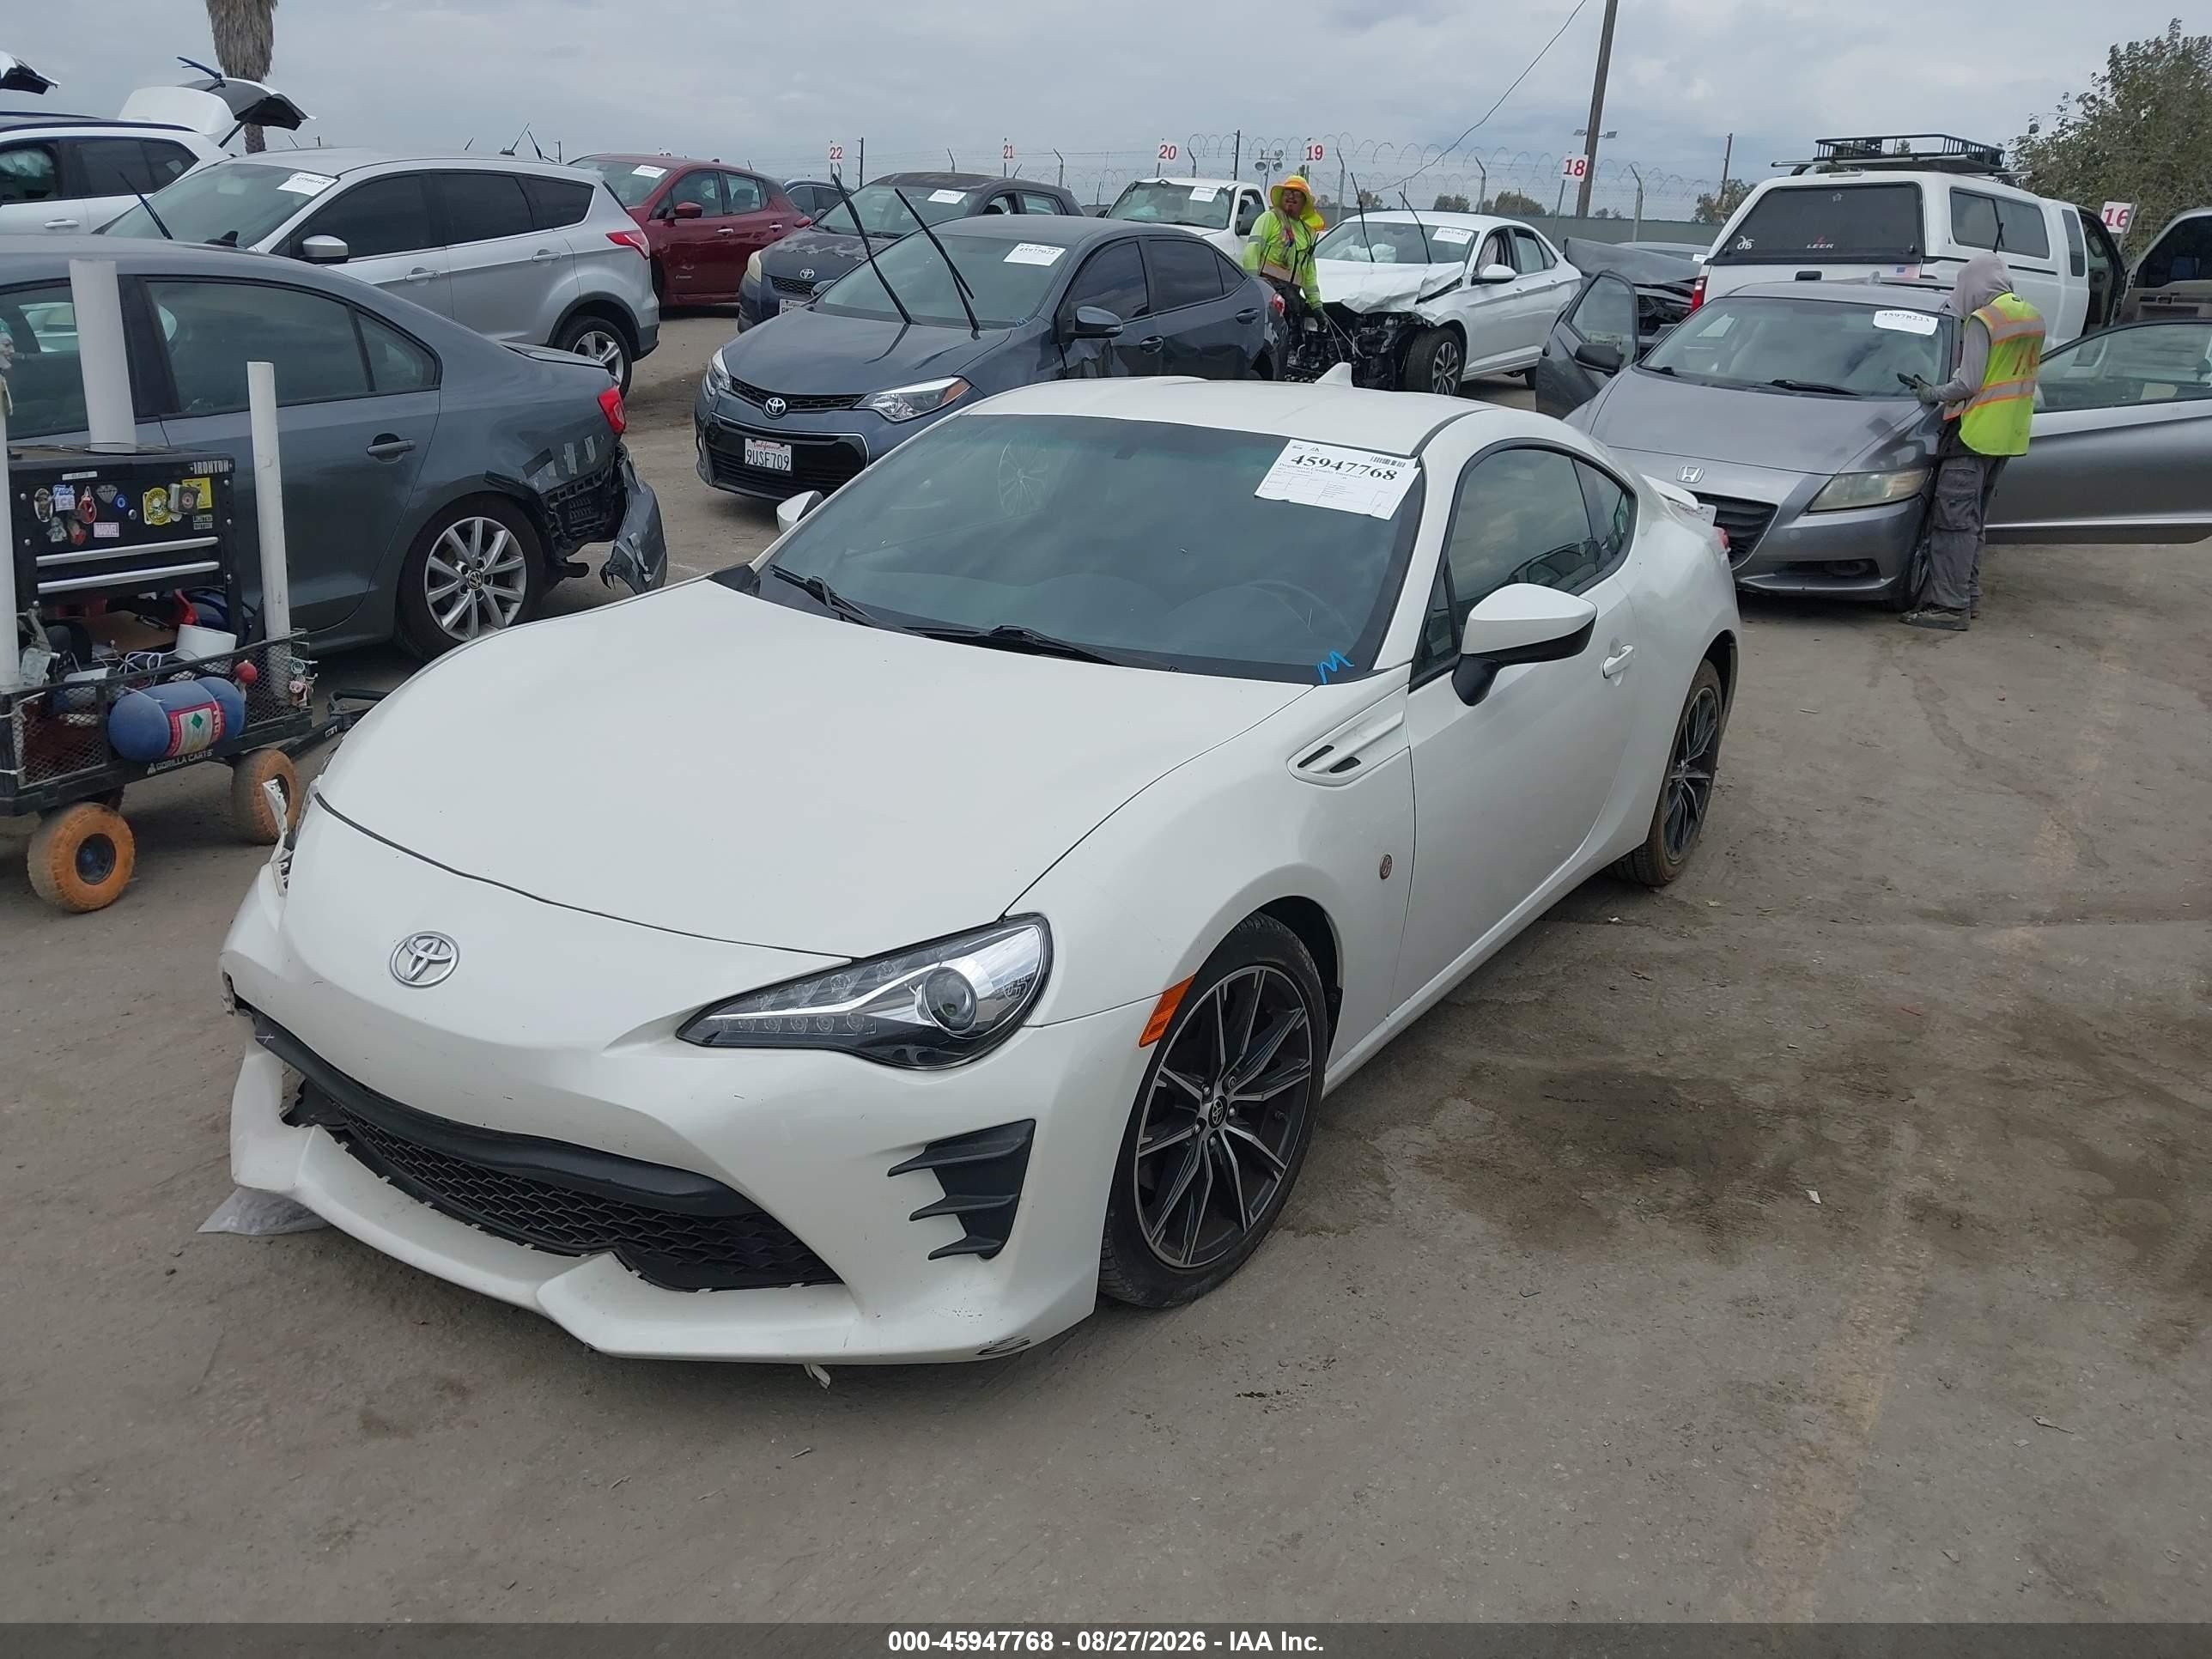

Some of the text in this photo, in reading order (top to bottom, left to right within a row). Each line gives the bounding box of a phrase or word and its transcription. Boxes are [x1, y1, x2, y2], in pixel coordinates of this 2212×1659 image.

[830, 147, 842, 160] 22
[1003, 144, 1013, 159] 21
[1158, 144, 1176, 160] 20
[1306, 144, 1323, 161] 19
[1563, 159, 1585, 176] 18
[2105, 208, 2130, 228] 16
[193, 460, 229, 474] IRONTON
[746, 449, 790, 471] 9USF709
[1291, 454, 1398, 481] 45947768
[155, 749, 213, 771] GORILLA CARTS
